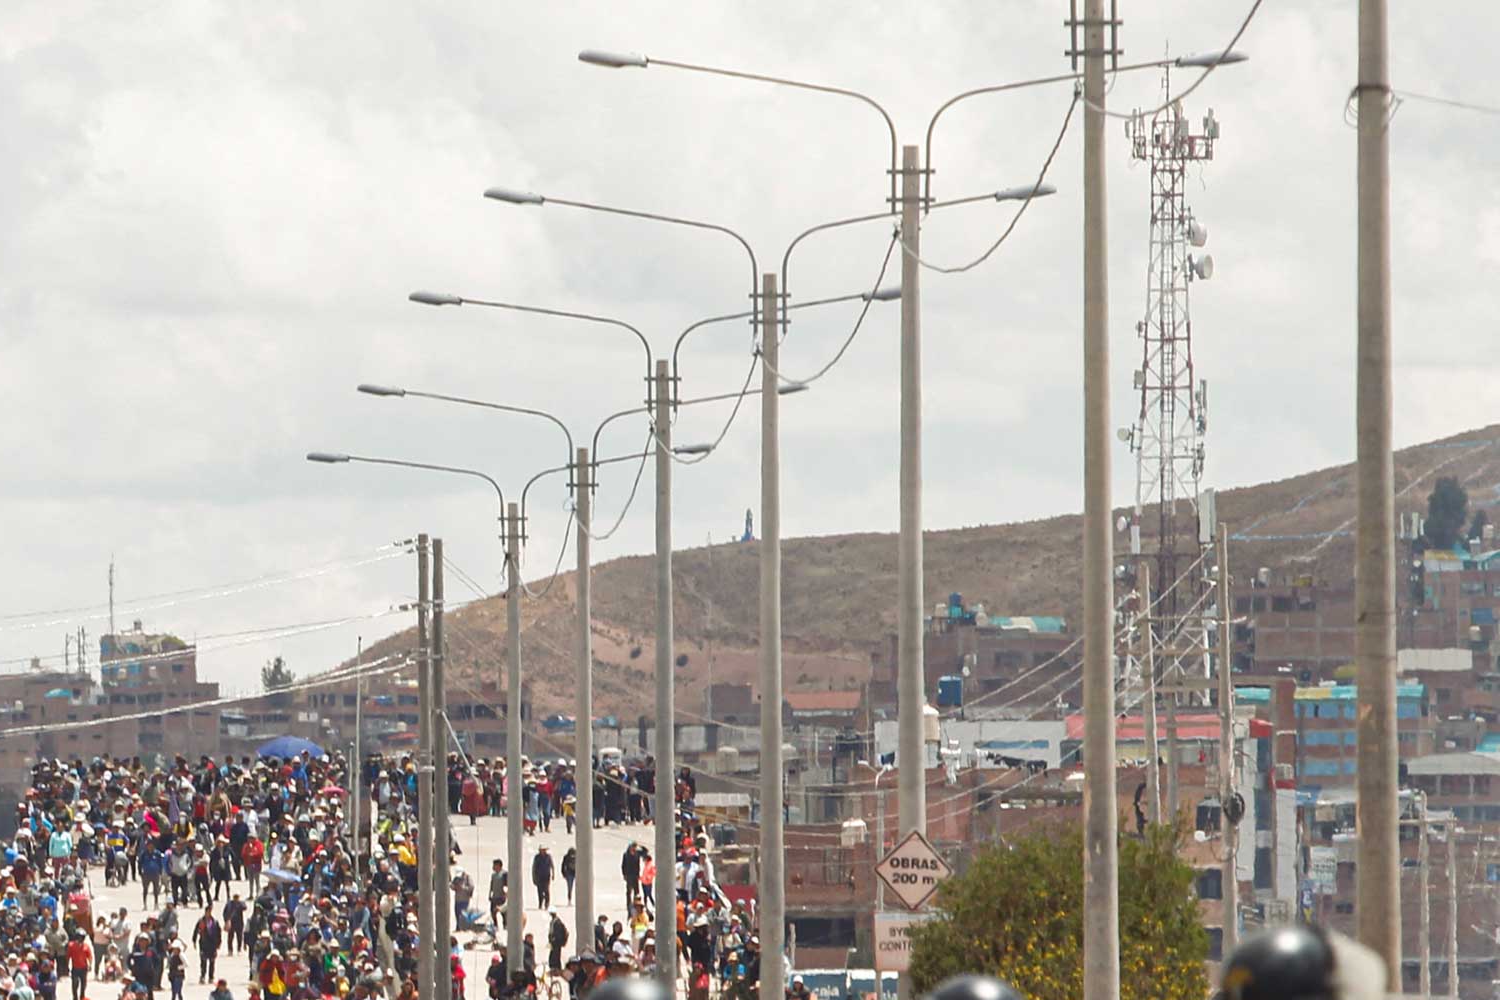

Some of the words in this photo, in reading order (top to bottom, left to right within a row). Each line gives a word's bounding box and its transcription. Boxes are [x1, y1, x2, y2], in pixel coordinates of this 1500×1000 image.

[889, 857, 938, 871] OBRAS
[891, 873, 919, 885] 200
[922, 876, 935, 885] m
